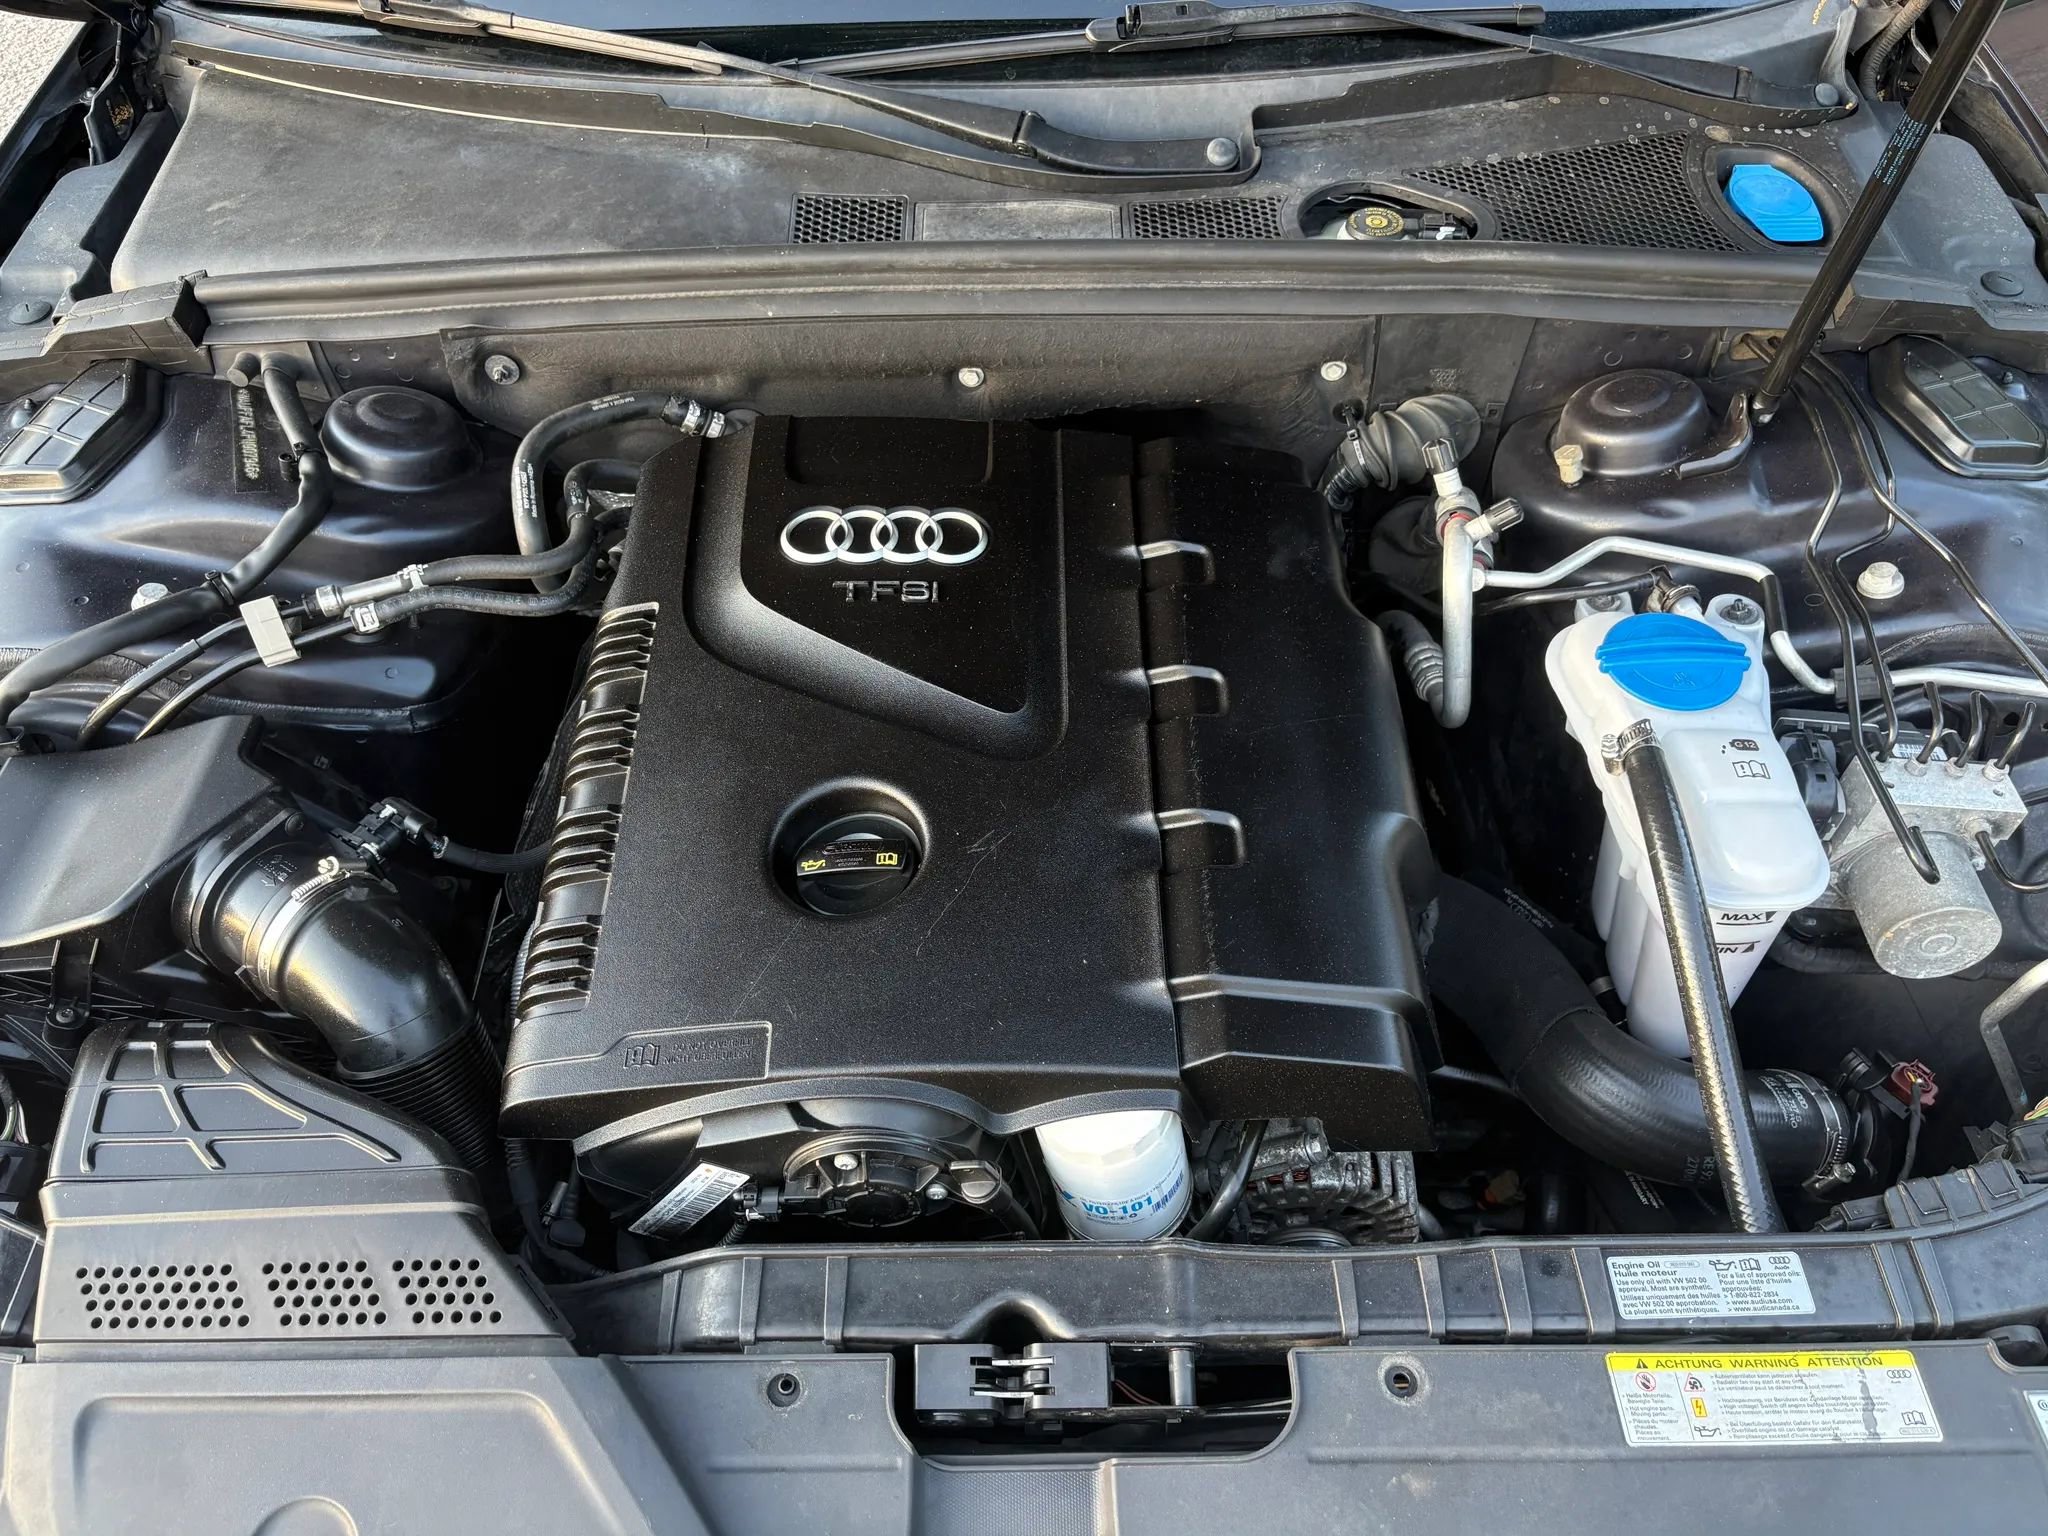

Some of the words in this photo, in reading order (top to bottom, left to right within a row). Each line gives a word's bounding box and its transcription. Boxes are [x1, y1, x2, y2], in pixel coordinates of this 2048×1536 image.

[832, 580, 939, 603] TFSI
[1734, 741, 1756, 749] G12
[1716, 946, 1739, 954] IN
[1081, 1196, 1153, 1215] VO-101
[1612, 1262, 1644, 1270] Engine
[1647, 1260, 1660, 1268] Oil
[1614, 1270, 1638, 1278] Huile
[1681, 1284, 1713, 1292] synthetic.
[1676, 1300, 1718, 1308] approbation.
[1732, 1298, 1793, 1306] www.audiusa.com
[1634, 1308, 1658, 1316] plupart
[1734, 1304, 1800, 1312] www.audicanada.ca
[1655, 1359, 1722, 1369] ACHTUNG
[1729, 1358, 1799, 1368] WARNING
[1808, 1357, 1883, 1367] ATTENTION
